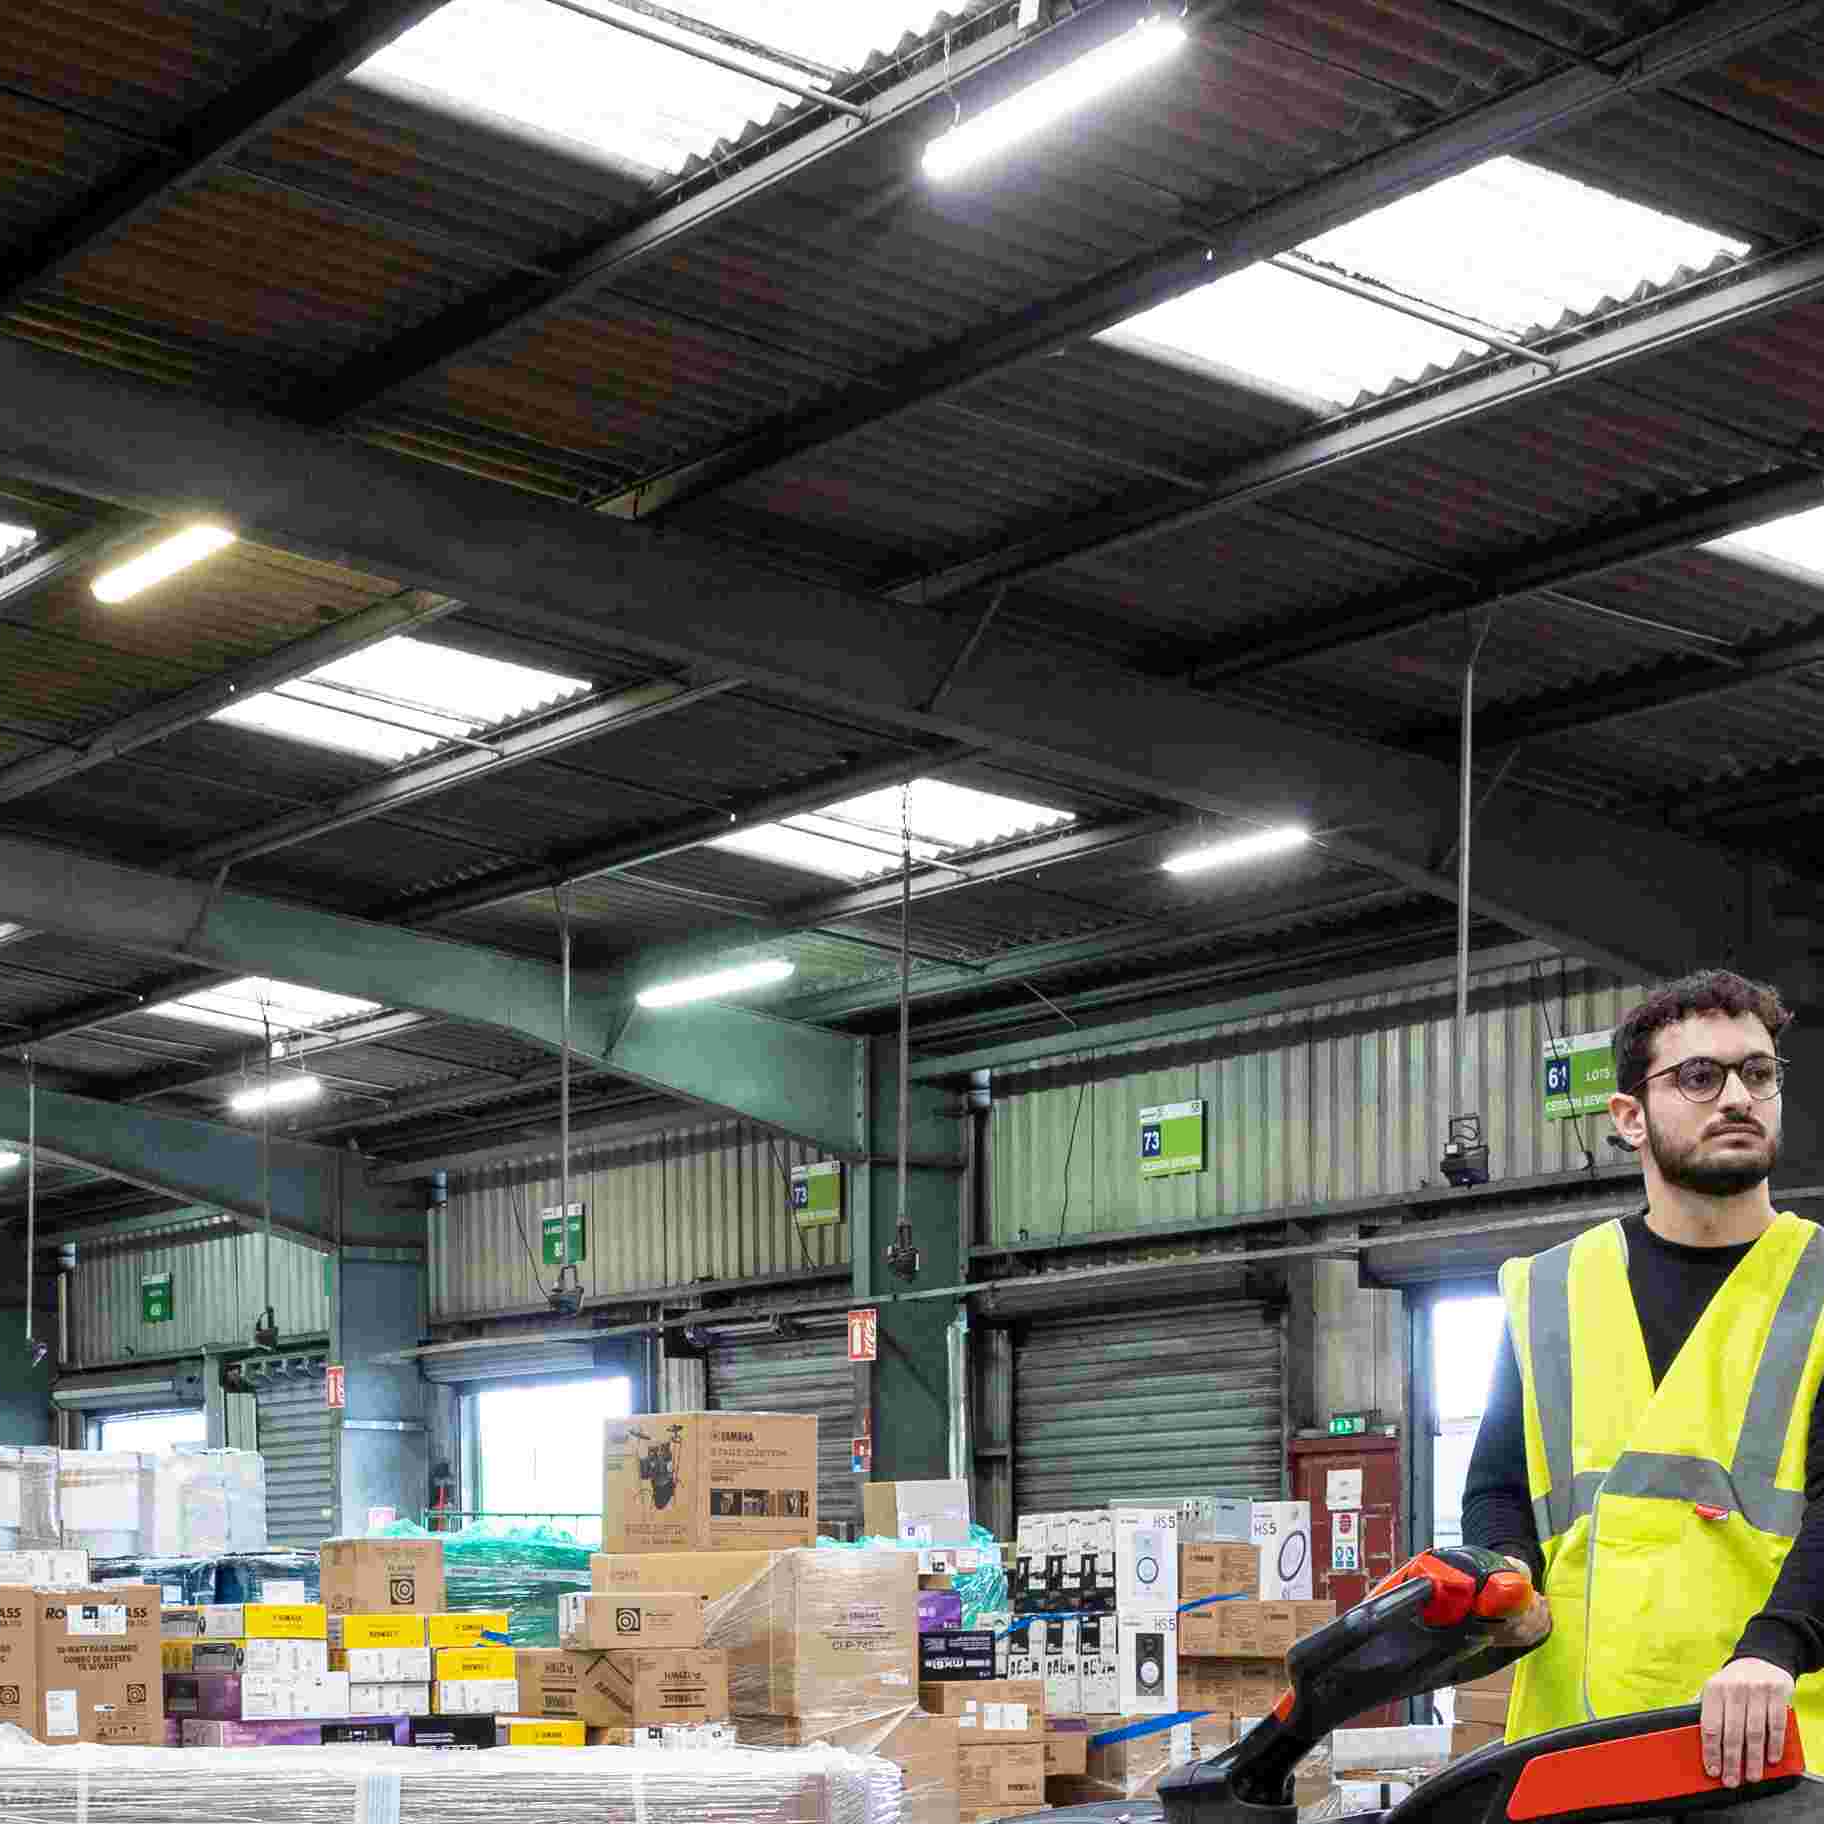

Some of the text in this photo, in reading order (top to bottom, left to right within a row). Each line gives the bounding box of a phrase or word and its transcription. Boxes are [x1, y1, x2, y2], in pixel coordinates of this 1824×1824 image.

[1143, 1131, 1160, 1150] 73
[793, 1186, 808, 1204] 73
[1152, 1516, 1176, 1529] HS5
[1253, 1522, 1278, 1536] HS5
[1154, 1617, 1176, 1630] HS5
